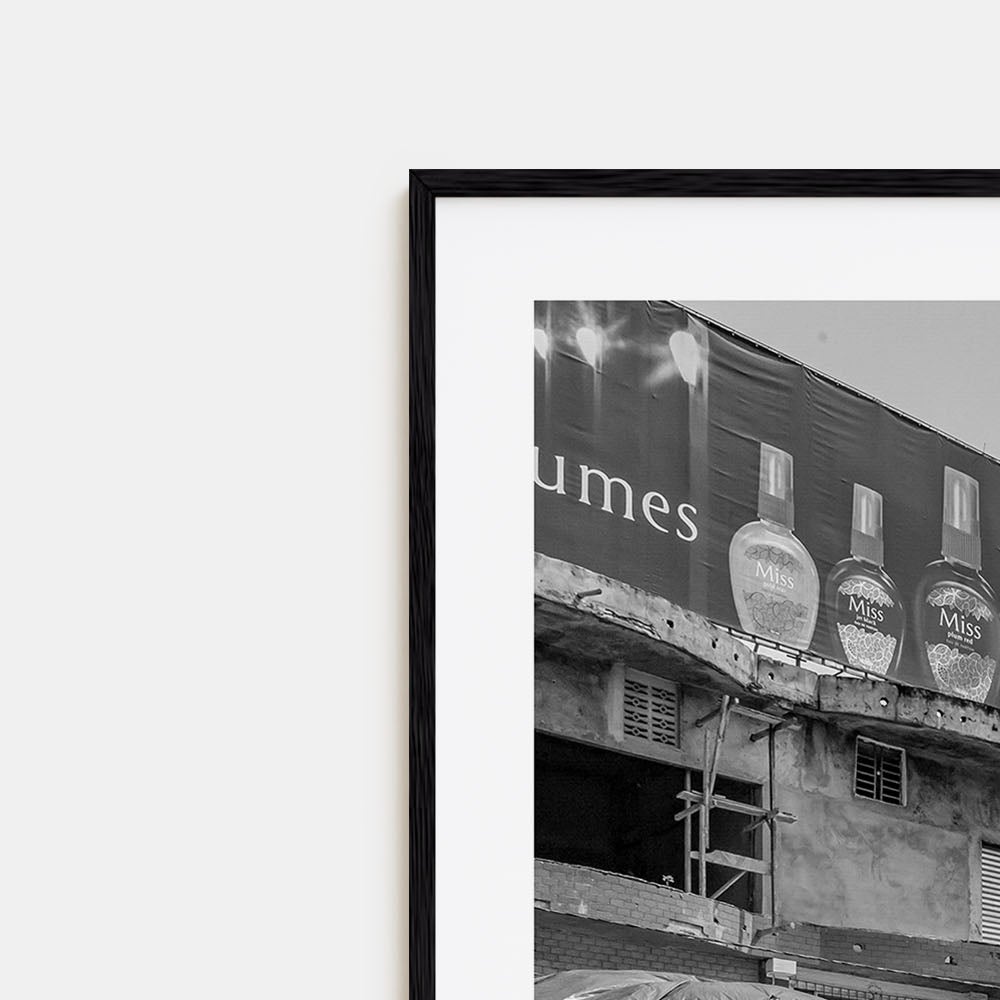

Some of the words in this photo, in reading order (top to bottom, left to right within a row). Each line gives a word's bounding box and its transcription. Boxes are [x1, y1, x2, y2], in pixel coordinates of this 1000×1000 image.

[755, 560, 795, 590] Miss
[848, 595, 884, 622] Miss
[939, 607, 982, 640] Miss
